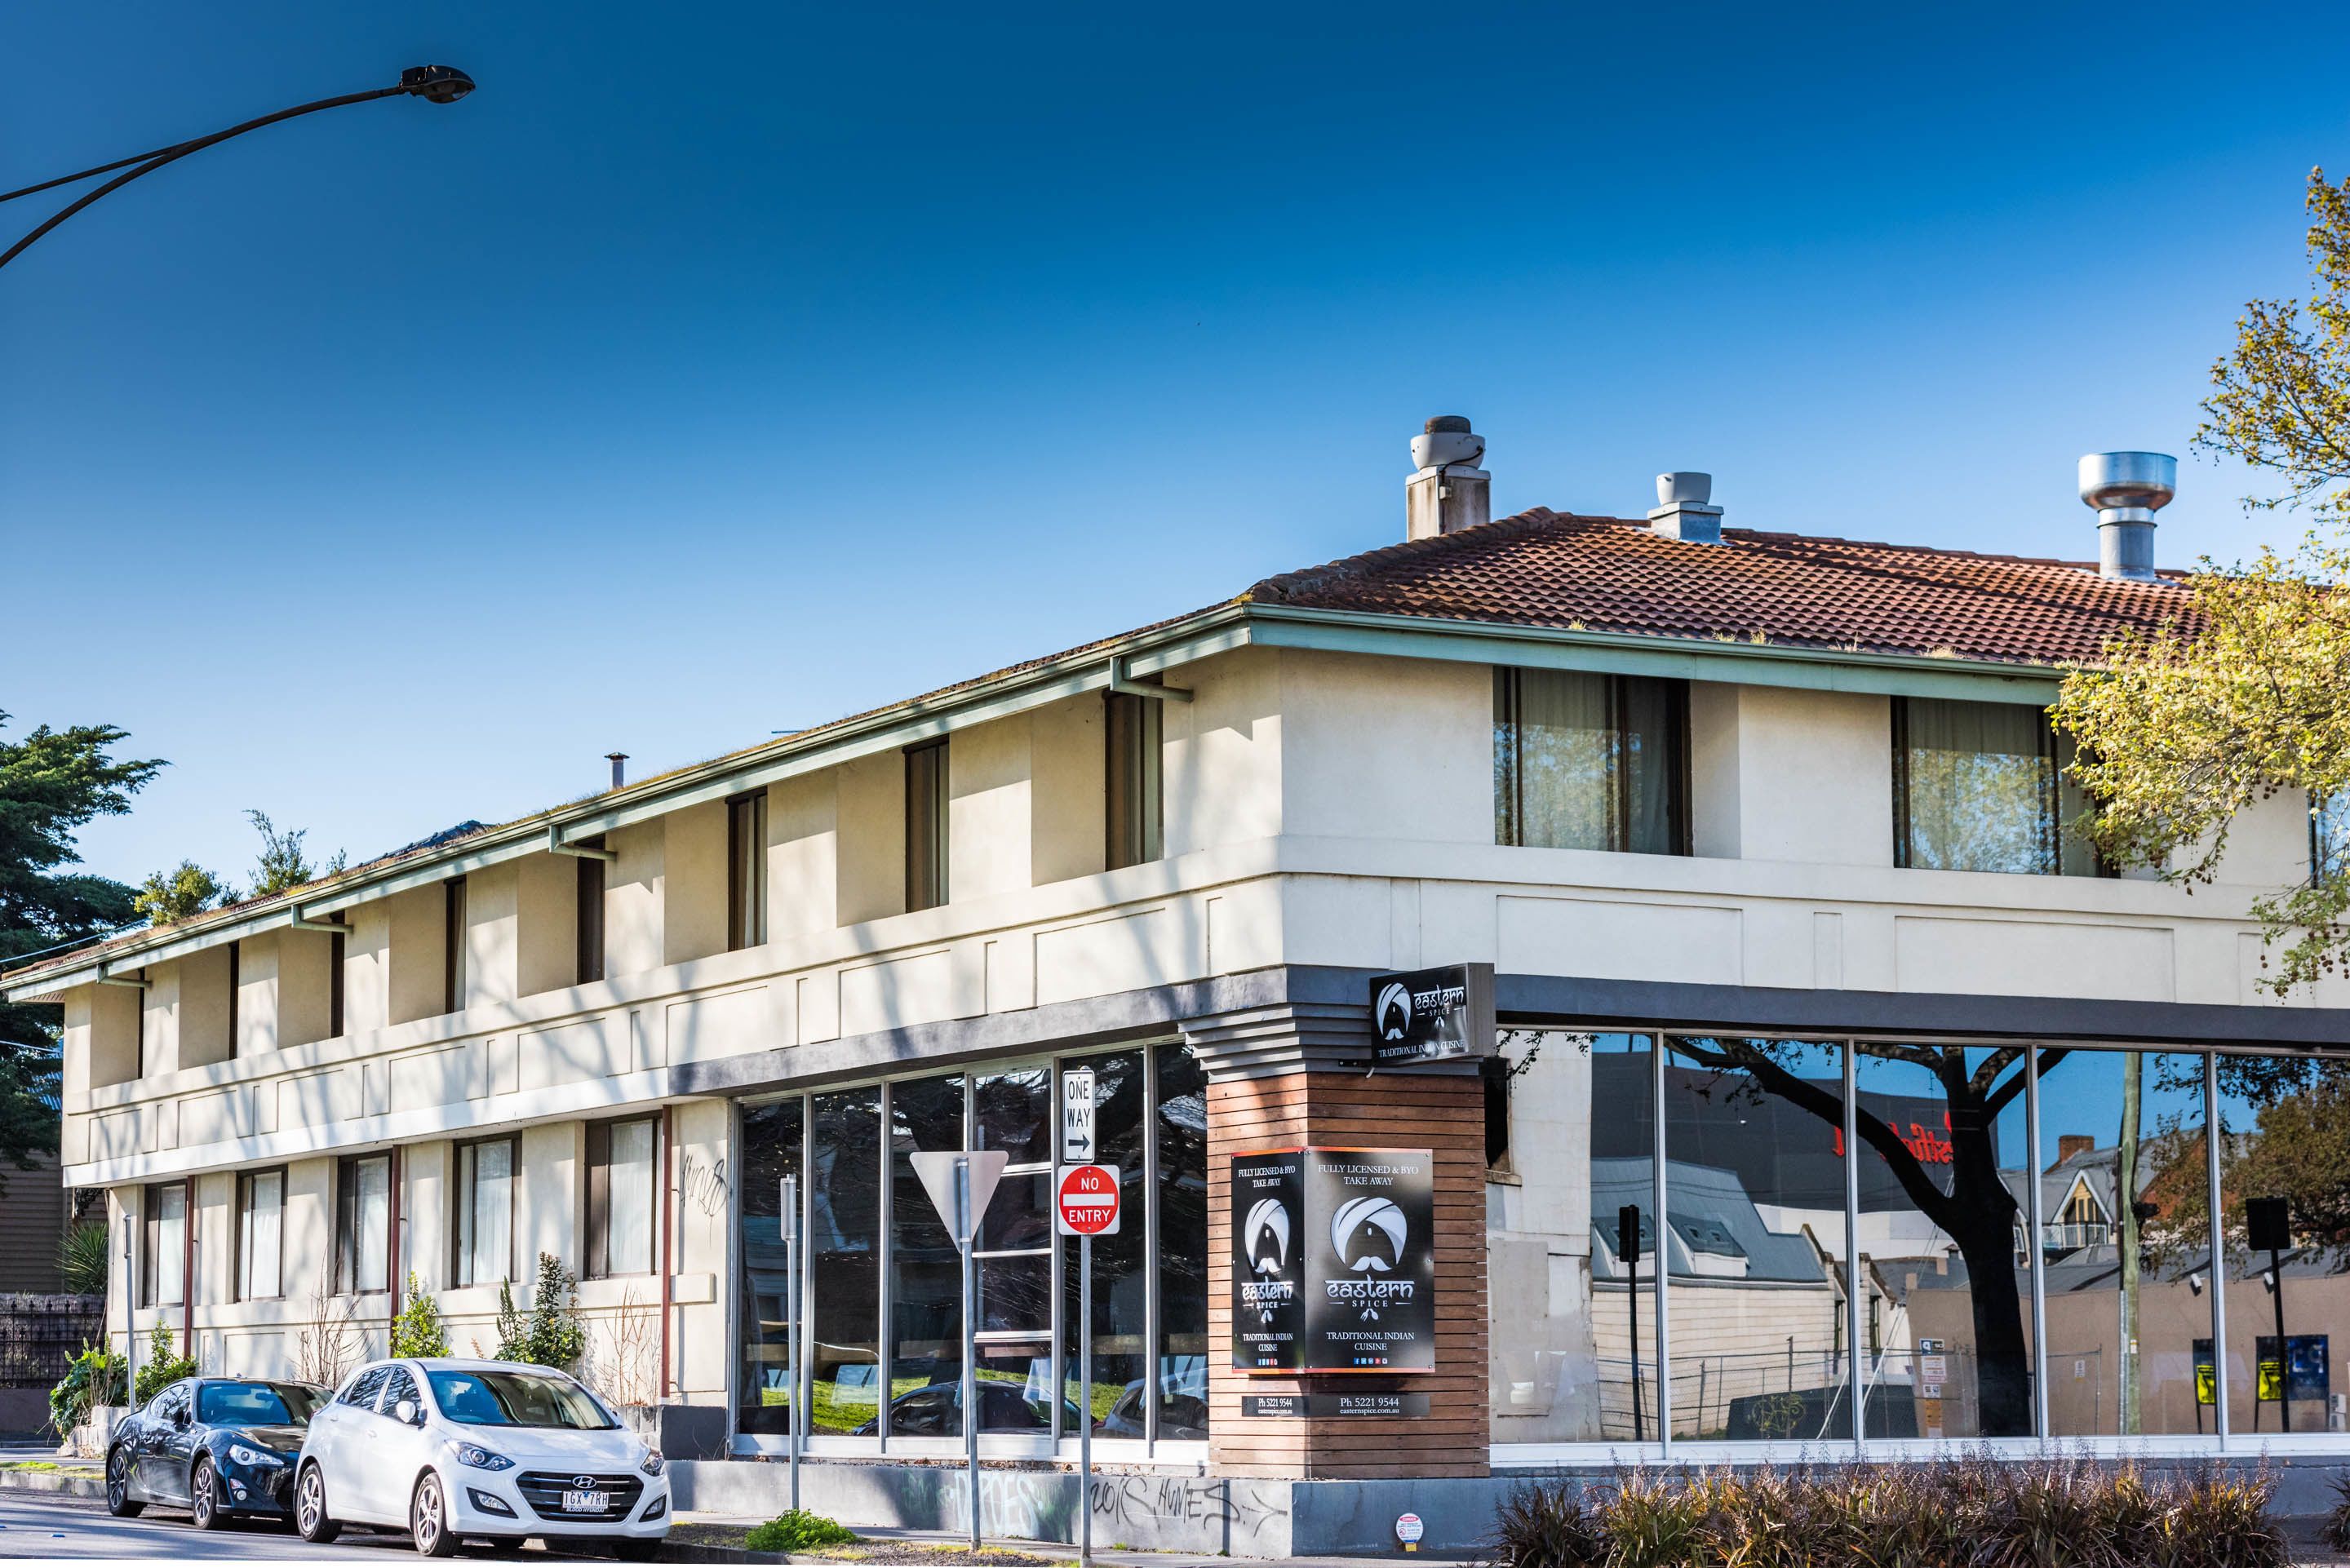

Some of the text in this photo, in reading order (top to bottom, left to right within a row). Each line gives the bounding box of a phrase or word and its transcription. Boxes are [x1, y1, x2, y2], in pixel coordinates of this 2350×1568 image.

[1413, 985, 1465, 1009] eastern
[1429, 1007, 1450, 1017] SPICE
[1379, 1045, 1417, 1057] TRADITIONAL
[1441, 1039, 1463, 1049] CUISINE
[1069, 1080, 1089, 1100] ONE
[1067, 1108, 1090, 1127] WAY
[1239, 1169, 1253, 1177] FULLY
[1254, 1167, 1279, 1176] LICENSED
[1284, 1165, 1296, 1174] BYO
[1319, 1164, 1419, 1175] FULLY LICENSED & BYO
[1081, 1177, 1099, 1190] NO
[1253, 1178, 1281, 1188] TAKE AWAY
[1343, 1176, 1394, 1185] TAKE AWAY
[1069, 1210, 1111, 1222] ENTRY
[1241, 1275, 1294, 1300] eastern
[1324, 1274, 1415, 1299] eastern
[1243, 1333, 1275, 1341] TRADITIONAL
[1327, 1331, 1414, 1340] TRADITIONAL INDIAN
[1354, 1343, 1387, 1351] CUISINE
[1258, 1397, 1292, 1407] Ph 5221 9544
[1340, 1397, 1399, 1406] Ph 5221 9544
[1340, 1407, 1399, 1415] easternspice.com.au
[565, 1493, 608, 1505] 1GX 7RH
